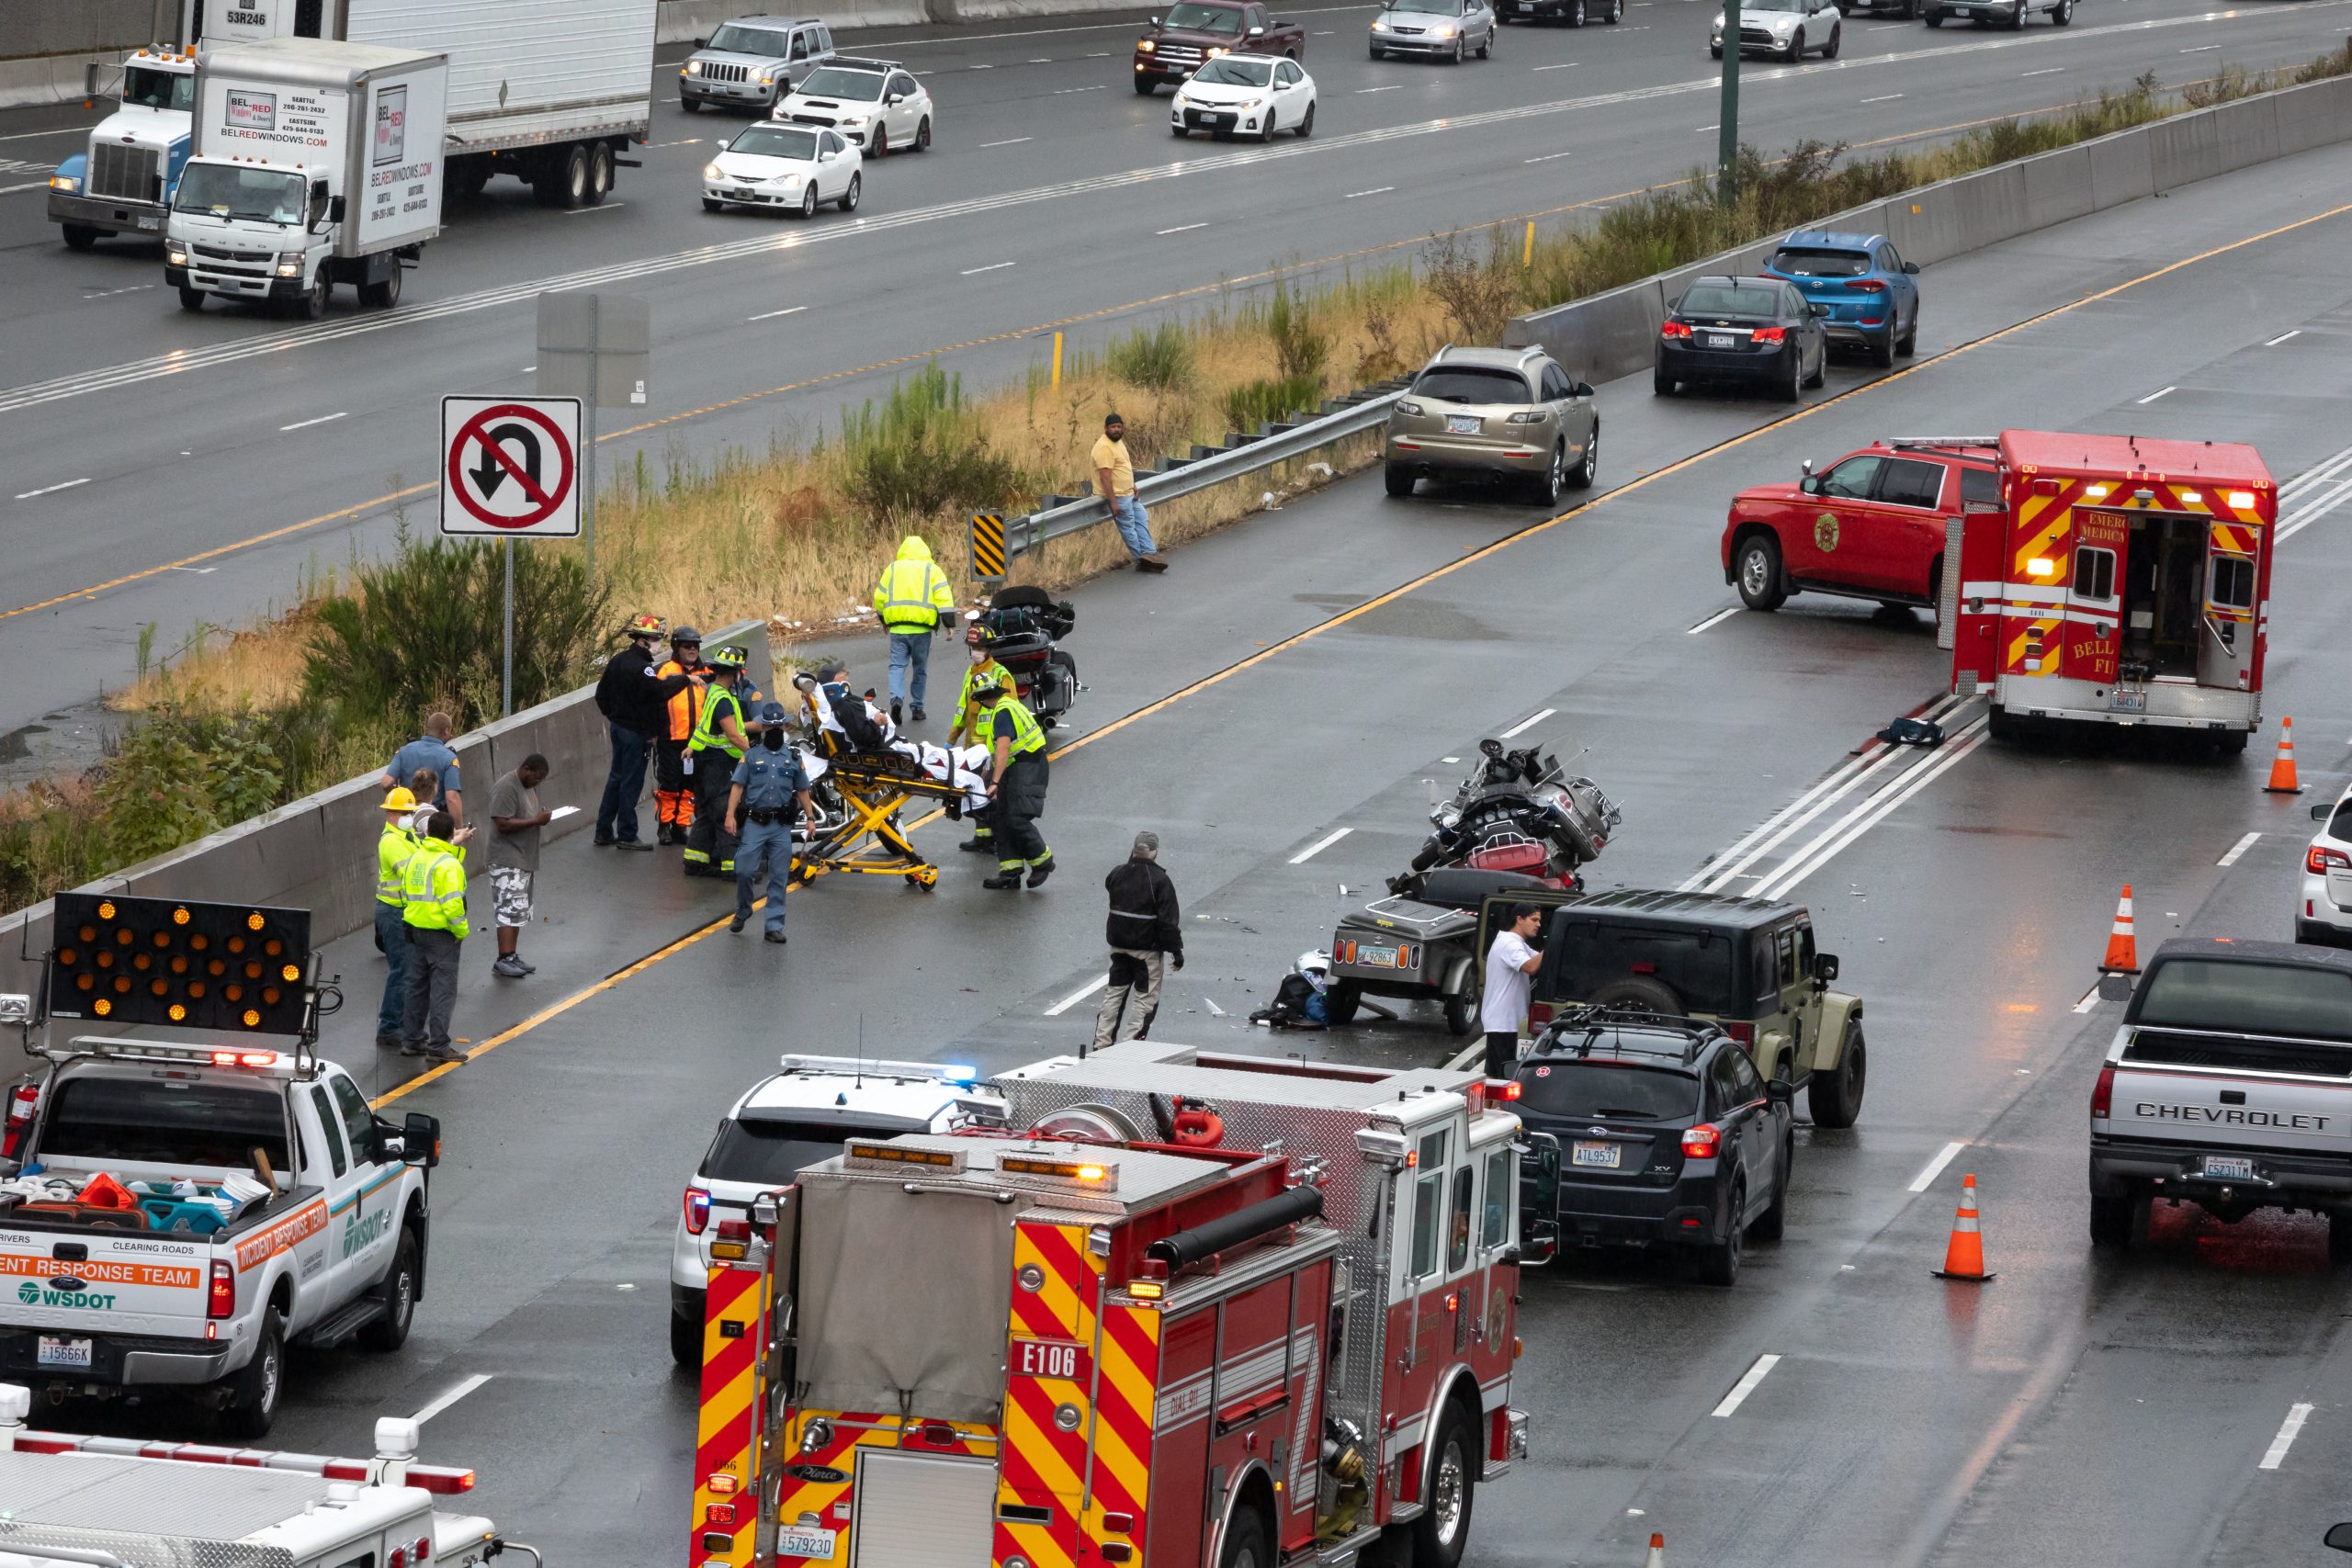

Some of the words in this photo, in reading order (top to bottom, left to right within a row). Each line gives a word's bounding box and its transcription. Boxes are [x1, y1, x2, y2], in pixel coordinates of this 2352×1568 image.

[228, 11, 266, 26] 53R246
[231, 97, 271, 113] BEL-RED
[288, 118, 316, 126] EASTSIDE
[220, 129, 327, 147] BELREDWINDOWS.COM
[371, 162, 432, 187] BELREDWINDOWS.COM
[2082, 525, 2124, 544] MEDICA
[2073, 641, 2114, 660] BELL
[2136, 1102, 2330, 1131] CHEVROLET
[1577, 1149, 1617, 1163] ATL9537
[2209, 1165, 2249, 1178] C52311M
[240, 1233, 273, 1267] INCIDENT
[273, 1213, 309, 1249] RESPONSE
[309, 1203, 325, 1230] TEAM
[353, 1209, 384, 1255] WSDOT
[112, 1242, 159, 1253] CLEARING
[162, 1245, 195, 1255] ROADS
[37, 1260, 134, 1281] RESPONSE
[141, 1268, 191, 1286] TEAM
[56, 1277, 79, 1289] Ford
[43, 1290, 116, 1310] WSDOT
[50, 1347, 88, 1361] 15666K
[1023, 1344, 1075, 1376] E106
[1170, 1393, 1185, 1416] DIAL
[799, 1466, 838, 1481] Pierce
[788, 1536, 831, 1554] 57923D
